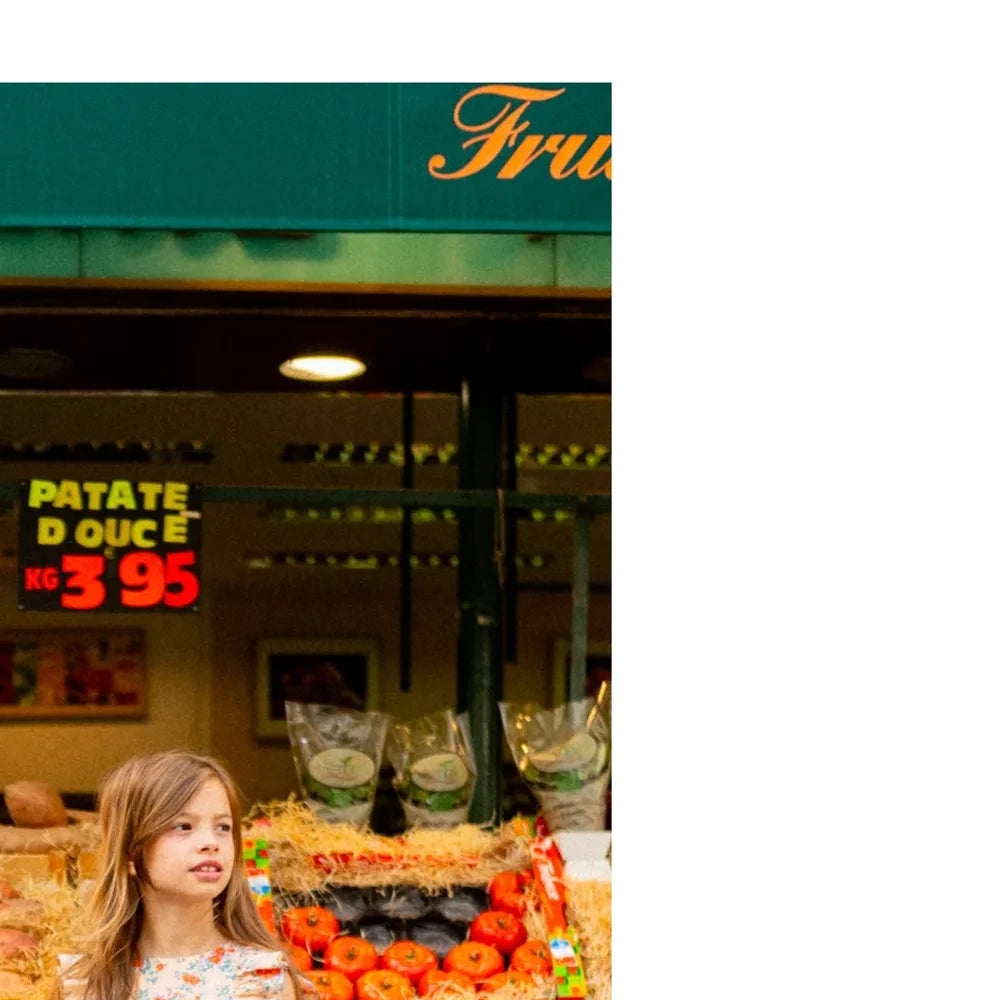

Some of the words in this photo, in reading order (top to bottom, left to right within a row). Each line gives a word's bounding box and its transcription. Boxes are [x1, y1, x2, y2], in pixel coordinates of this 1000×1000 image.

[428, 83, 611, 180] Fru
[28, 479, 190, 511] PATATE
[37, 514, 190, 549] DOUCE
[24, 566, 60, 591] KG
